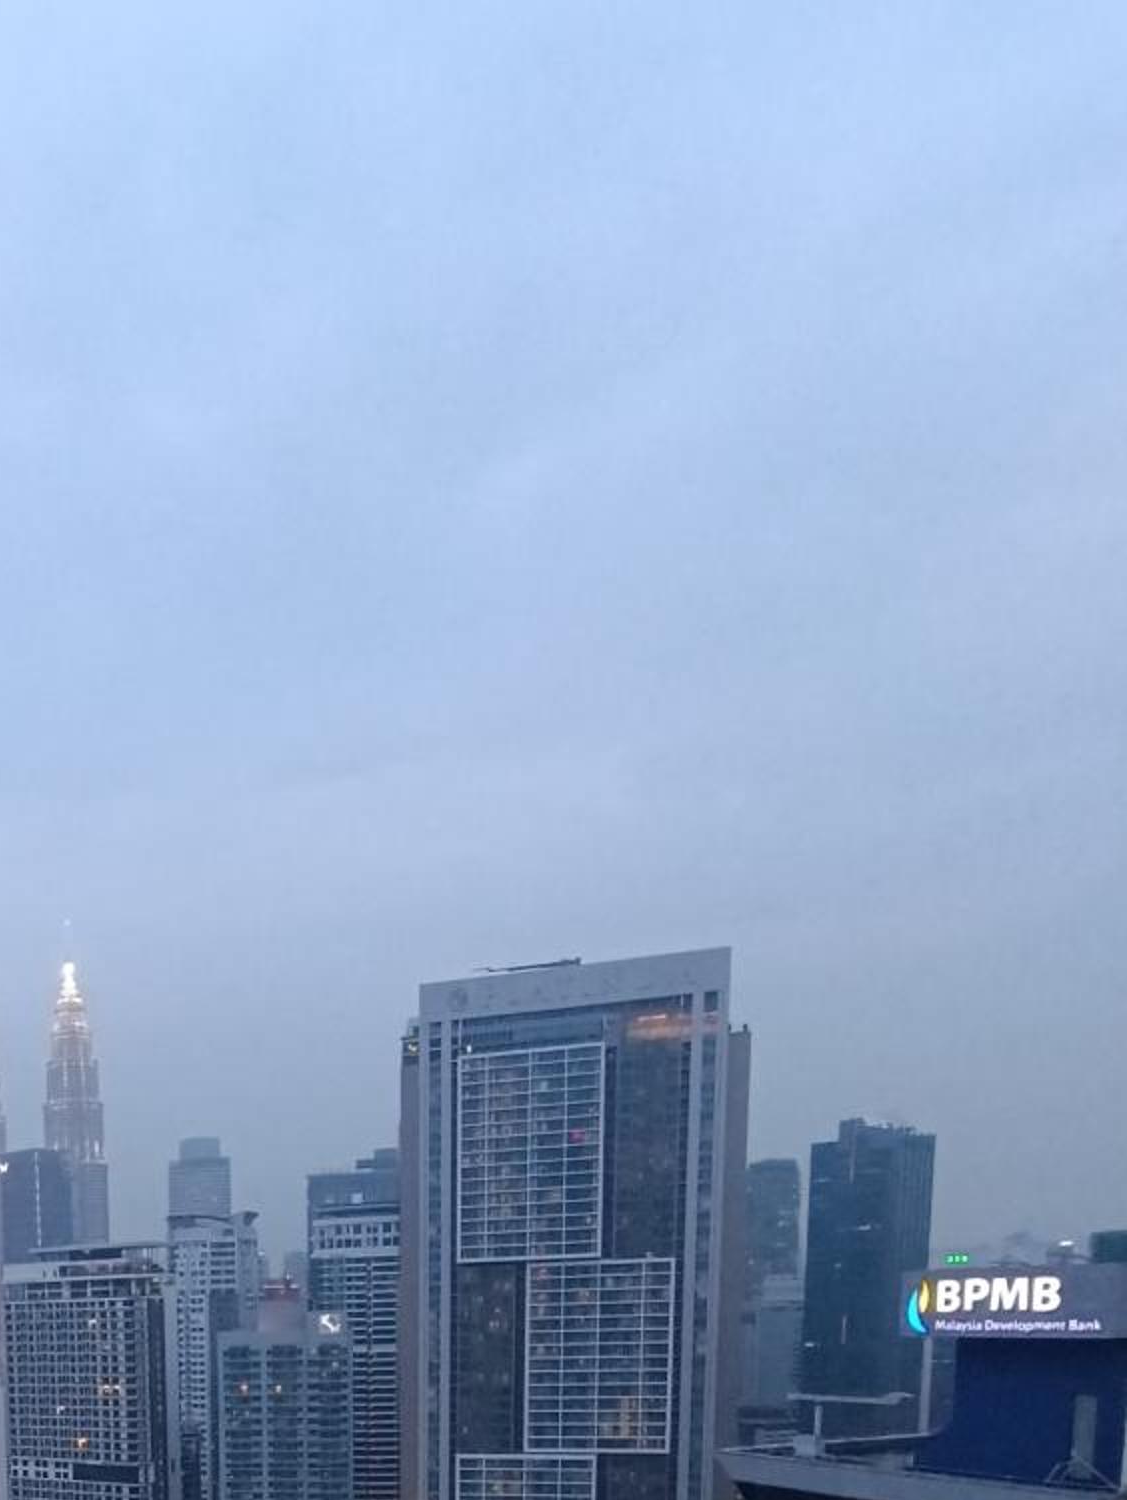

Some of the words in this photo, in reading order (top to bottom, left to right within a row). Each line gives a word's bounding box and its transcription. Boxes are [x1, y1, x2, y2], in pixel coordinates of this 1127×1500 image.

[935, 1276, 1062, 1313] BPMB
[934, 1319, 983, 1332] Malaysia
[984, 1319, 1066, 1332] Development
[1068, 1319, 1102, 1331] Bank
